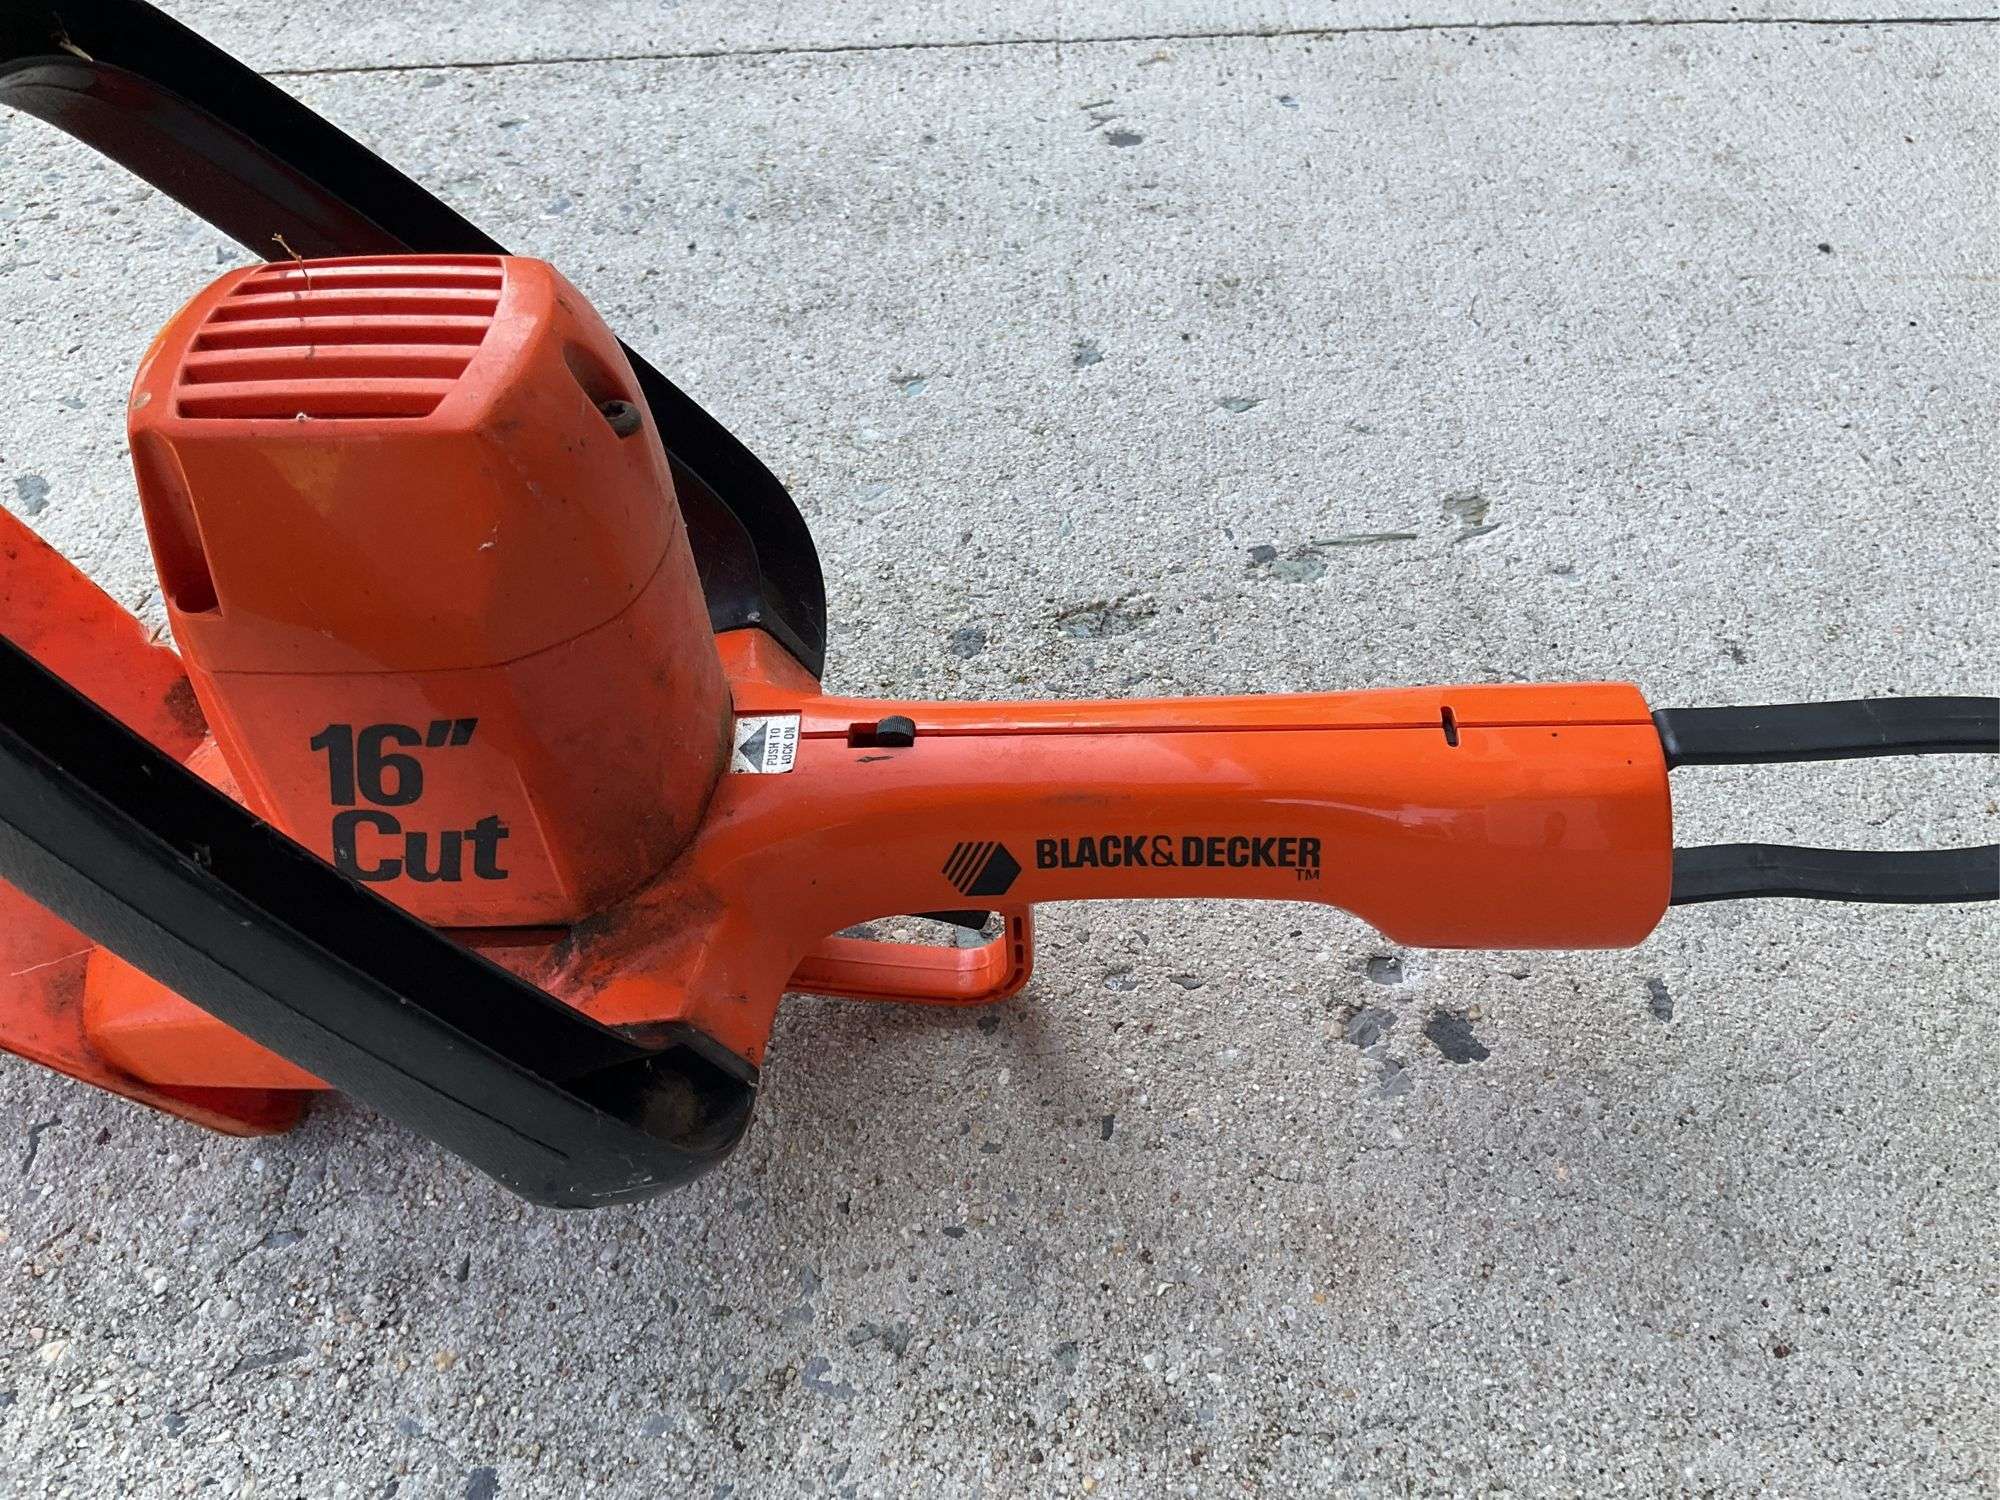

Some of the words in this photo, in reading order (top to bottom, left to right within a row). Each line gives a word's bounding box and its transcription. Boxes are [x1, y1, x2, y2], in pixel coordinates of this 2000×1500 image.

[770, 727, 781, 739] TO
[784, 726, 795, 739] ON
[766, 742, 780, 766] PUSH
[781, 742, 794, 765] LOCK
[332, 809, 509, 882] Cut
[1036, 835, 1320, 869] BLACK&DECKER
